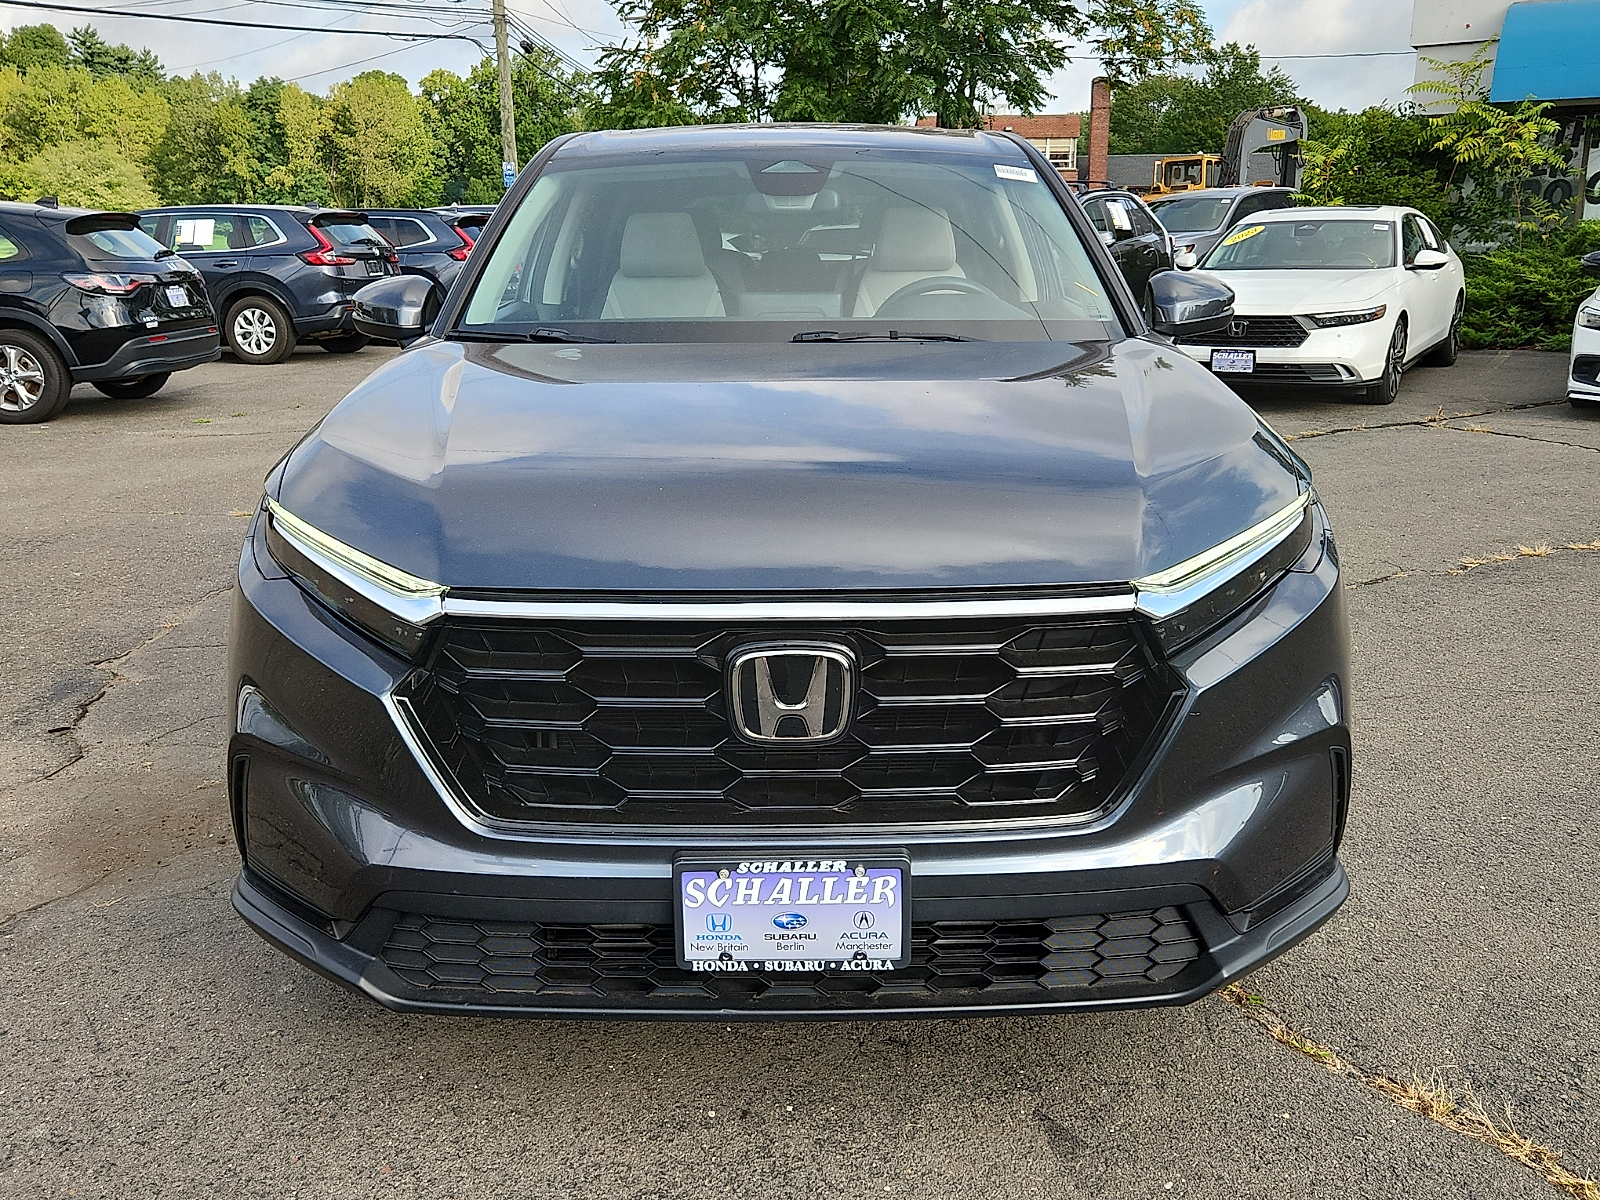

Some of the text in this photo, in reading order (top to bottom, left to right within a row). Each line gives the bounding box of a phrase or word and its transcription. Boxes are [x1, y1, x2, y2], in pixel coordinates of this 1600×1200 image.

[1213, 352, 1253, 360] SCHALLER
[736, 860, 848, 874] SCHALLER
[684, 875, 898, 908] SCHALLER
[763, 933, 817, 941] SUBARU
[839, 932, 889, 940] ACURA
[690, 942, 749, 952] New Britain
[776, 942, 805, 951] Berlin
[835, 941, 893, 951] Manchester
[692, 959, 895, 972] HONDA SUBARU ACURA
